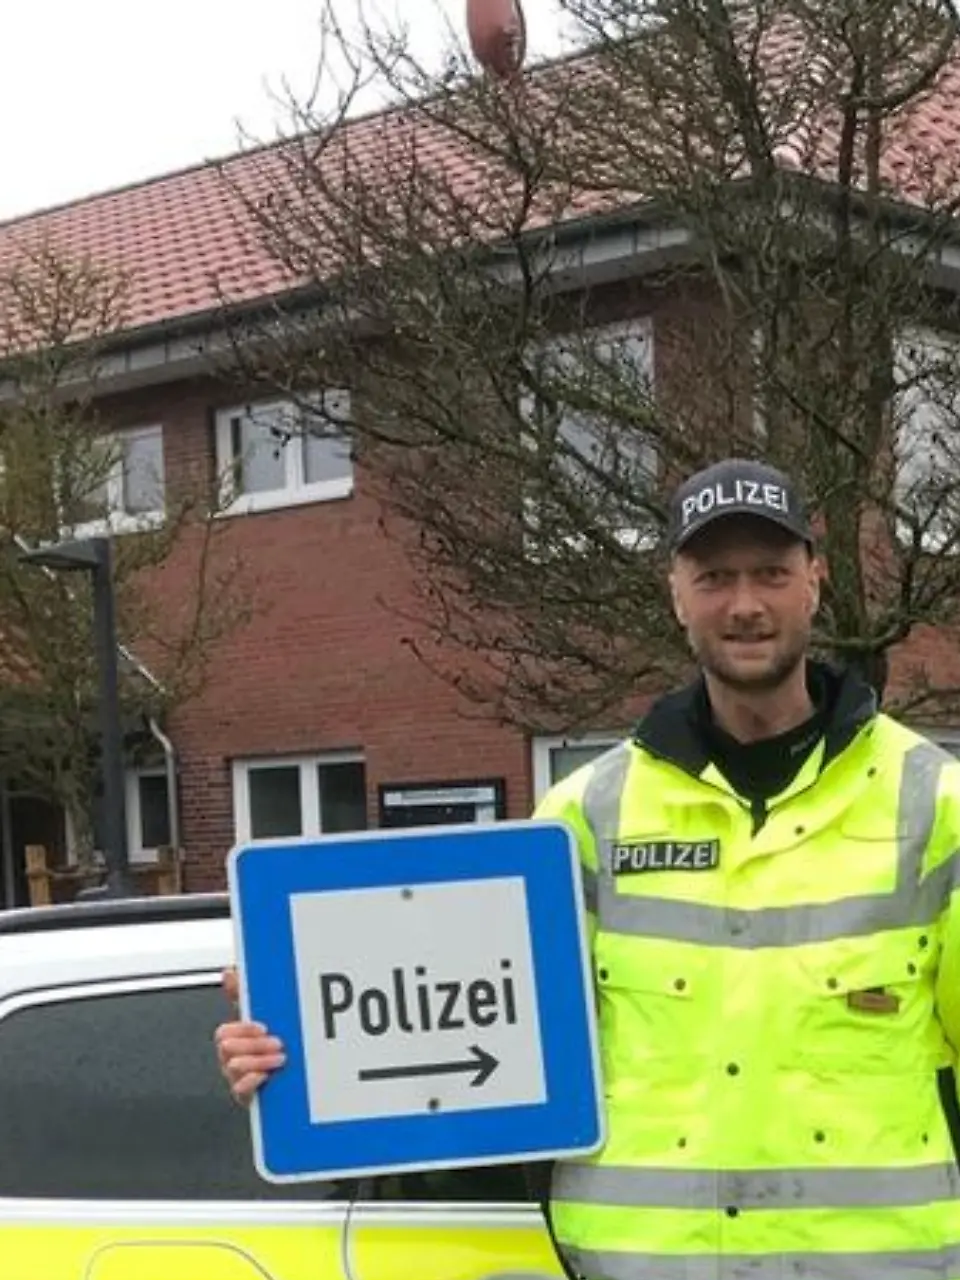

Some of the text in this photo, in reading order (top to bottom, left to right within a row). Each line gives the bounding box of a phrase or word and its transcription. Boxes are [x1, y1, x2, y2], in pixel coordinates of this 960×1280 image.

[682, 479, 789, 526] POLIZEI
[613, 843, 718, 871] POLIZEI
[319, 958, 517, 1039] Polizei
